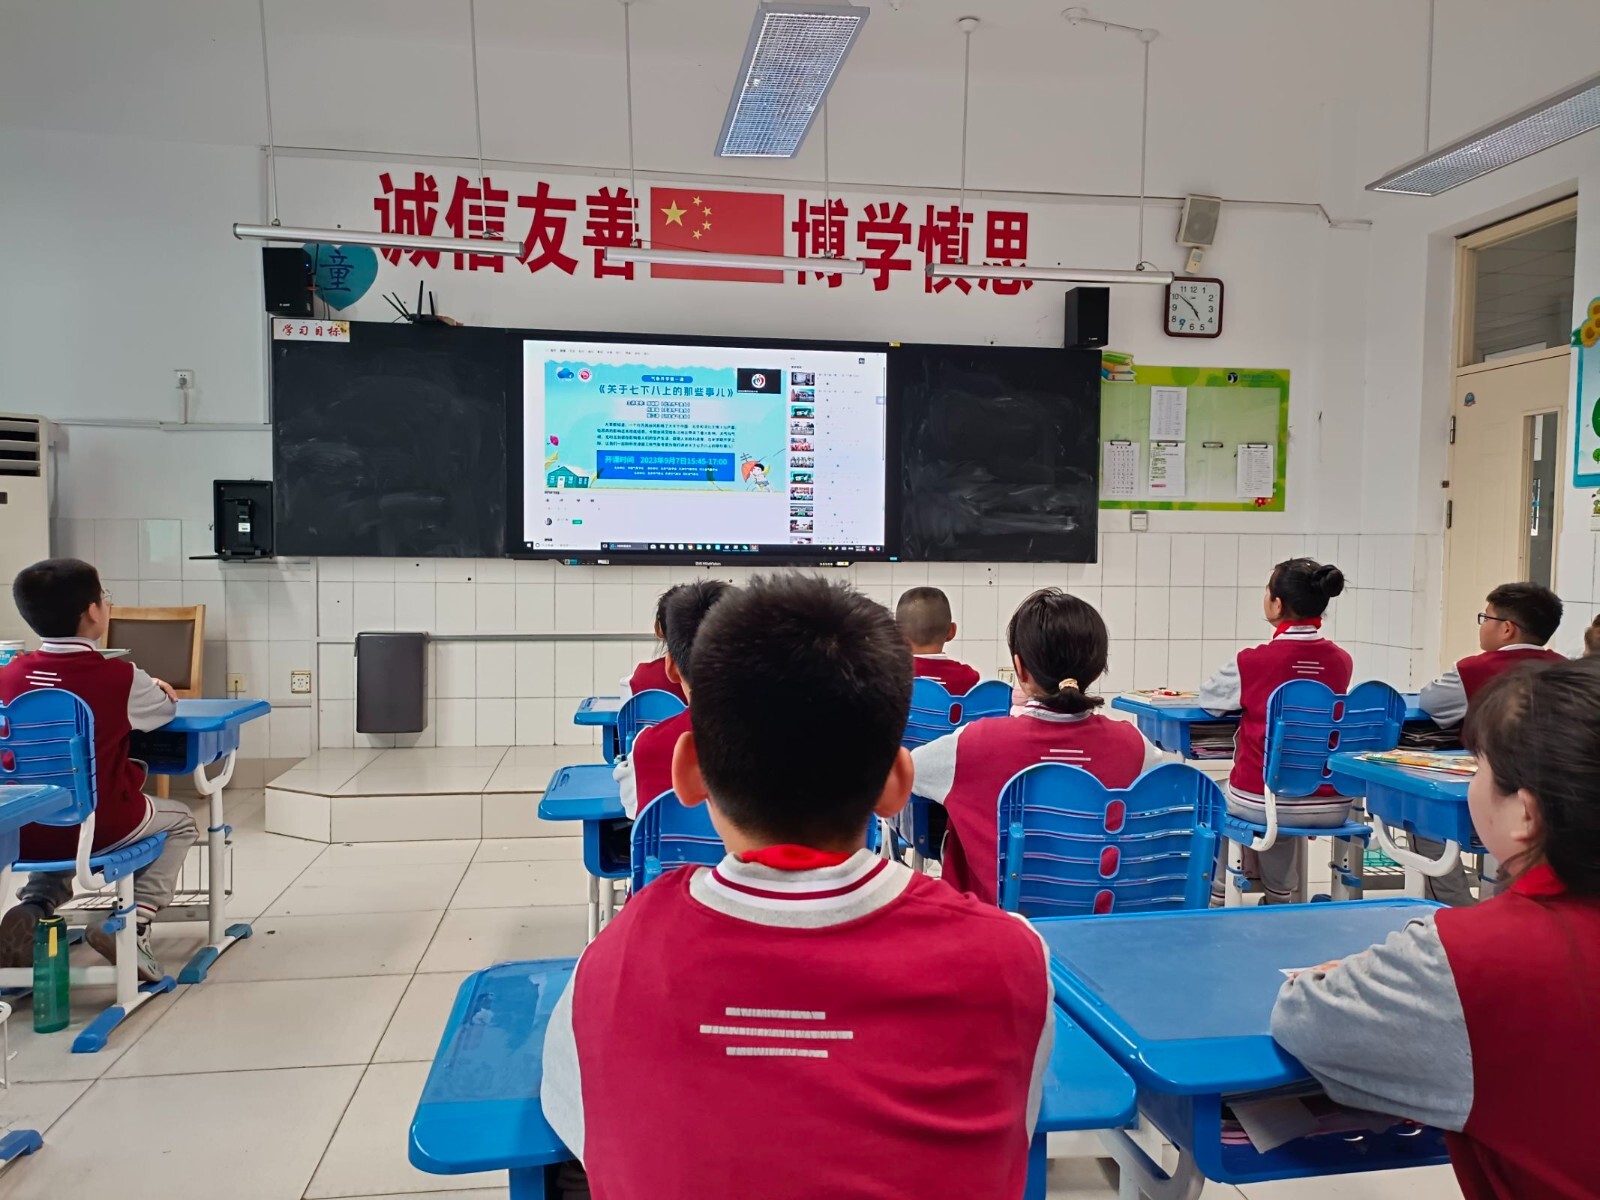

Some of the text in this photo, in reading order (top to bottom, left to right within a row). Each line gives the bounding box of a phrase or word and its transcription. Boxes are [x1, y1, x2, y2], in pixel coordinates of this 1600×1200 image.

[374, 172, 1034, 296] 诚信友善 博学慎思
[319, 249, 354, 292] 童
[1208, 305, 1214, 313] 3
[1171, 315, 1177, 323] 8
[282, 324, 342, 337] 学习目标
[1189, 323, 1195, 331] 6
[599, 384, 734, 398] 《关于七下八上的那些事儿》
[605, 455, 635, 464] 开课时间
